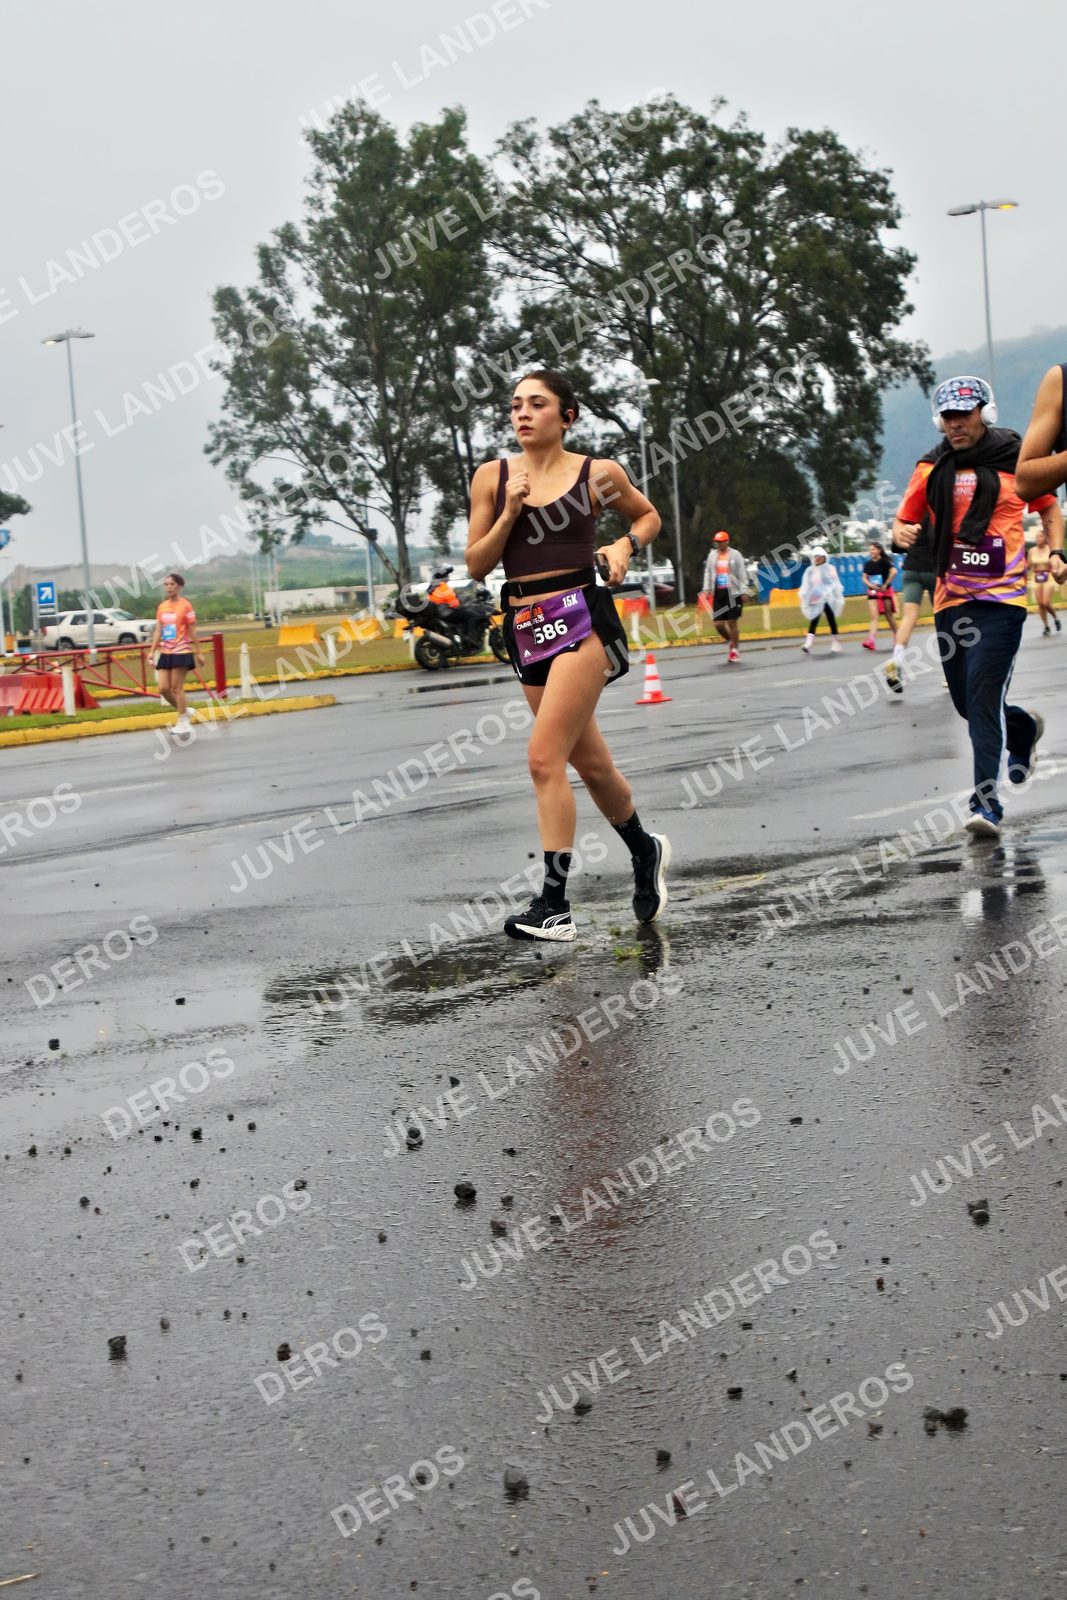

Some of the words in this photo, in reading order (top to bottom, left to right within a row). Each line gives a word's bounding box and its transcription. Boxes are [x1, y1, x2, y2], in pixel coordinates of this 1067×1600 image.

[962, 551, 990, 566] 509
[562, 593, 578, 608] 15K
[533, 619, 568, 644] 586
